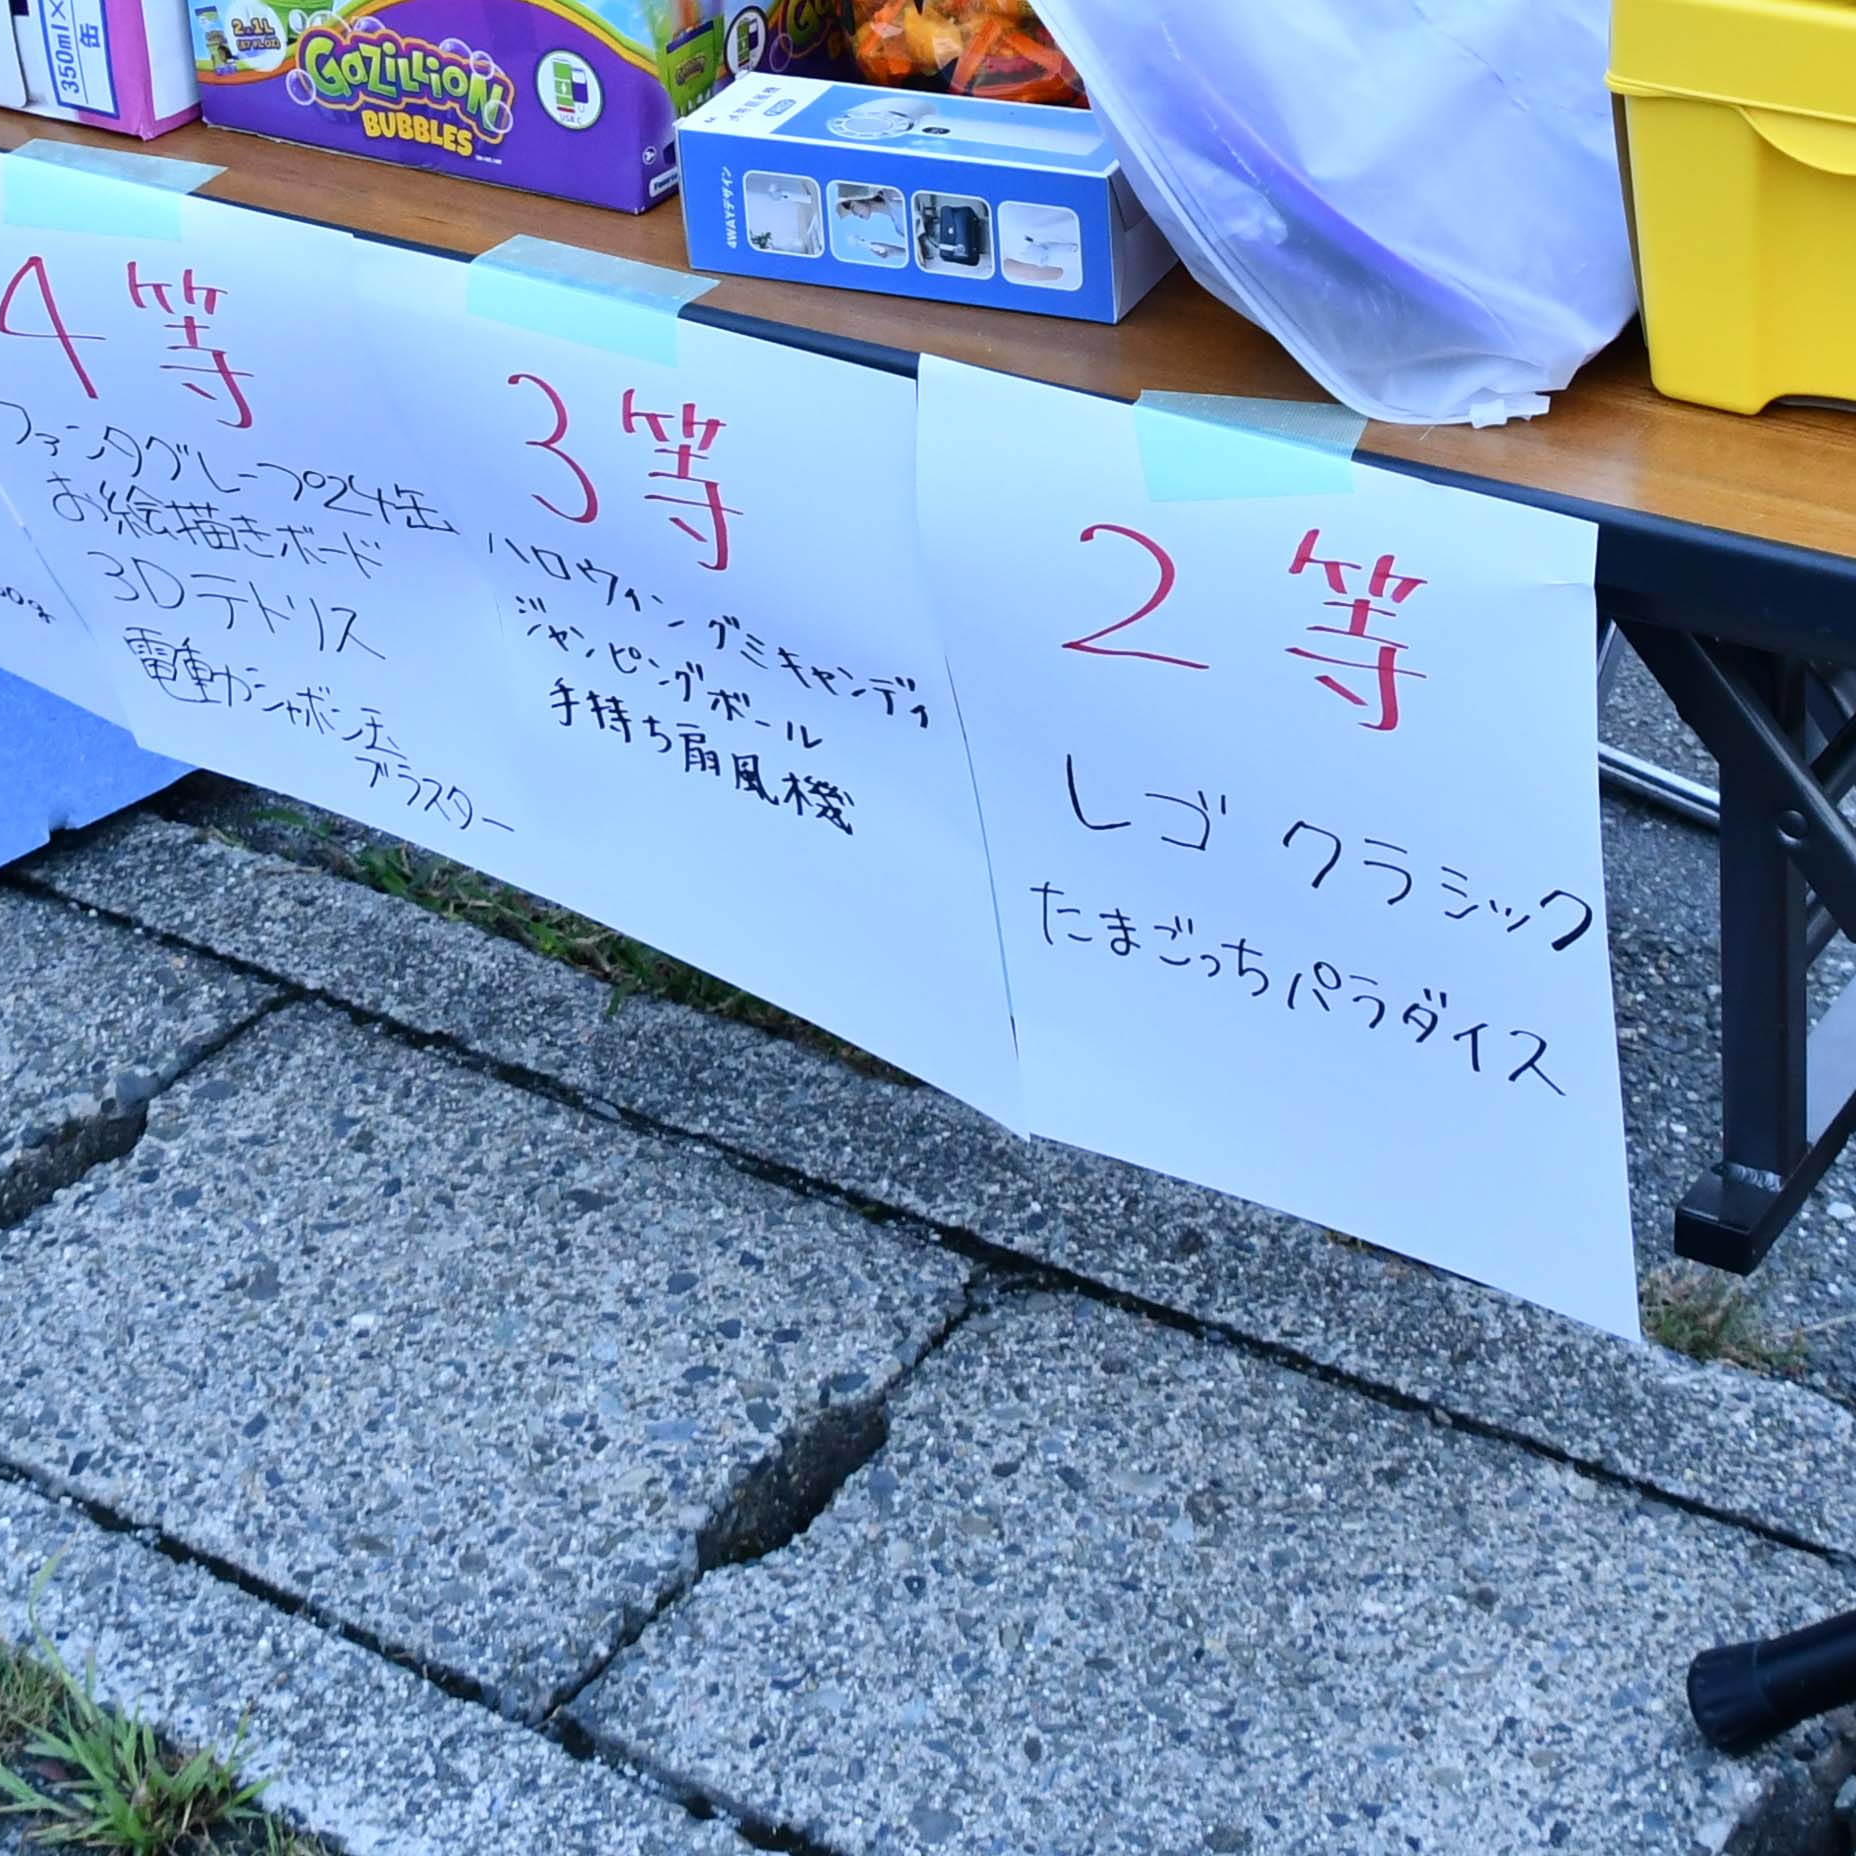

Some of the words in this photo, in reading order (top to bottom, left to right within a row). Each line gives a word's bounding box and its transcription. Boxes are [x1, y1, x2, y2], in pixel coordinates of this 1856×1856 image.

[79, 23, 101, 50] 缶
[362, 109, 474, 157] BUBBLES
[721, 165, 739, 249] 4WAYデザイン
[46, 471, 383, 579] お絵描きボード
[507, 373, 745, 573] 3等
[515, 594, 824, 750] ジャンピングボール
[1062, 524, 1430, 731] 2等
[354, 755, 515, 833] ブラスター
[549, 677, 856, 837] 手持ち扇風機
[1066, 753, 1228, 852] レゴ
[1282, 820, 1595, 953] クラシック
[1029, 881, 1567, 1097] たまごっちパラダイス
